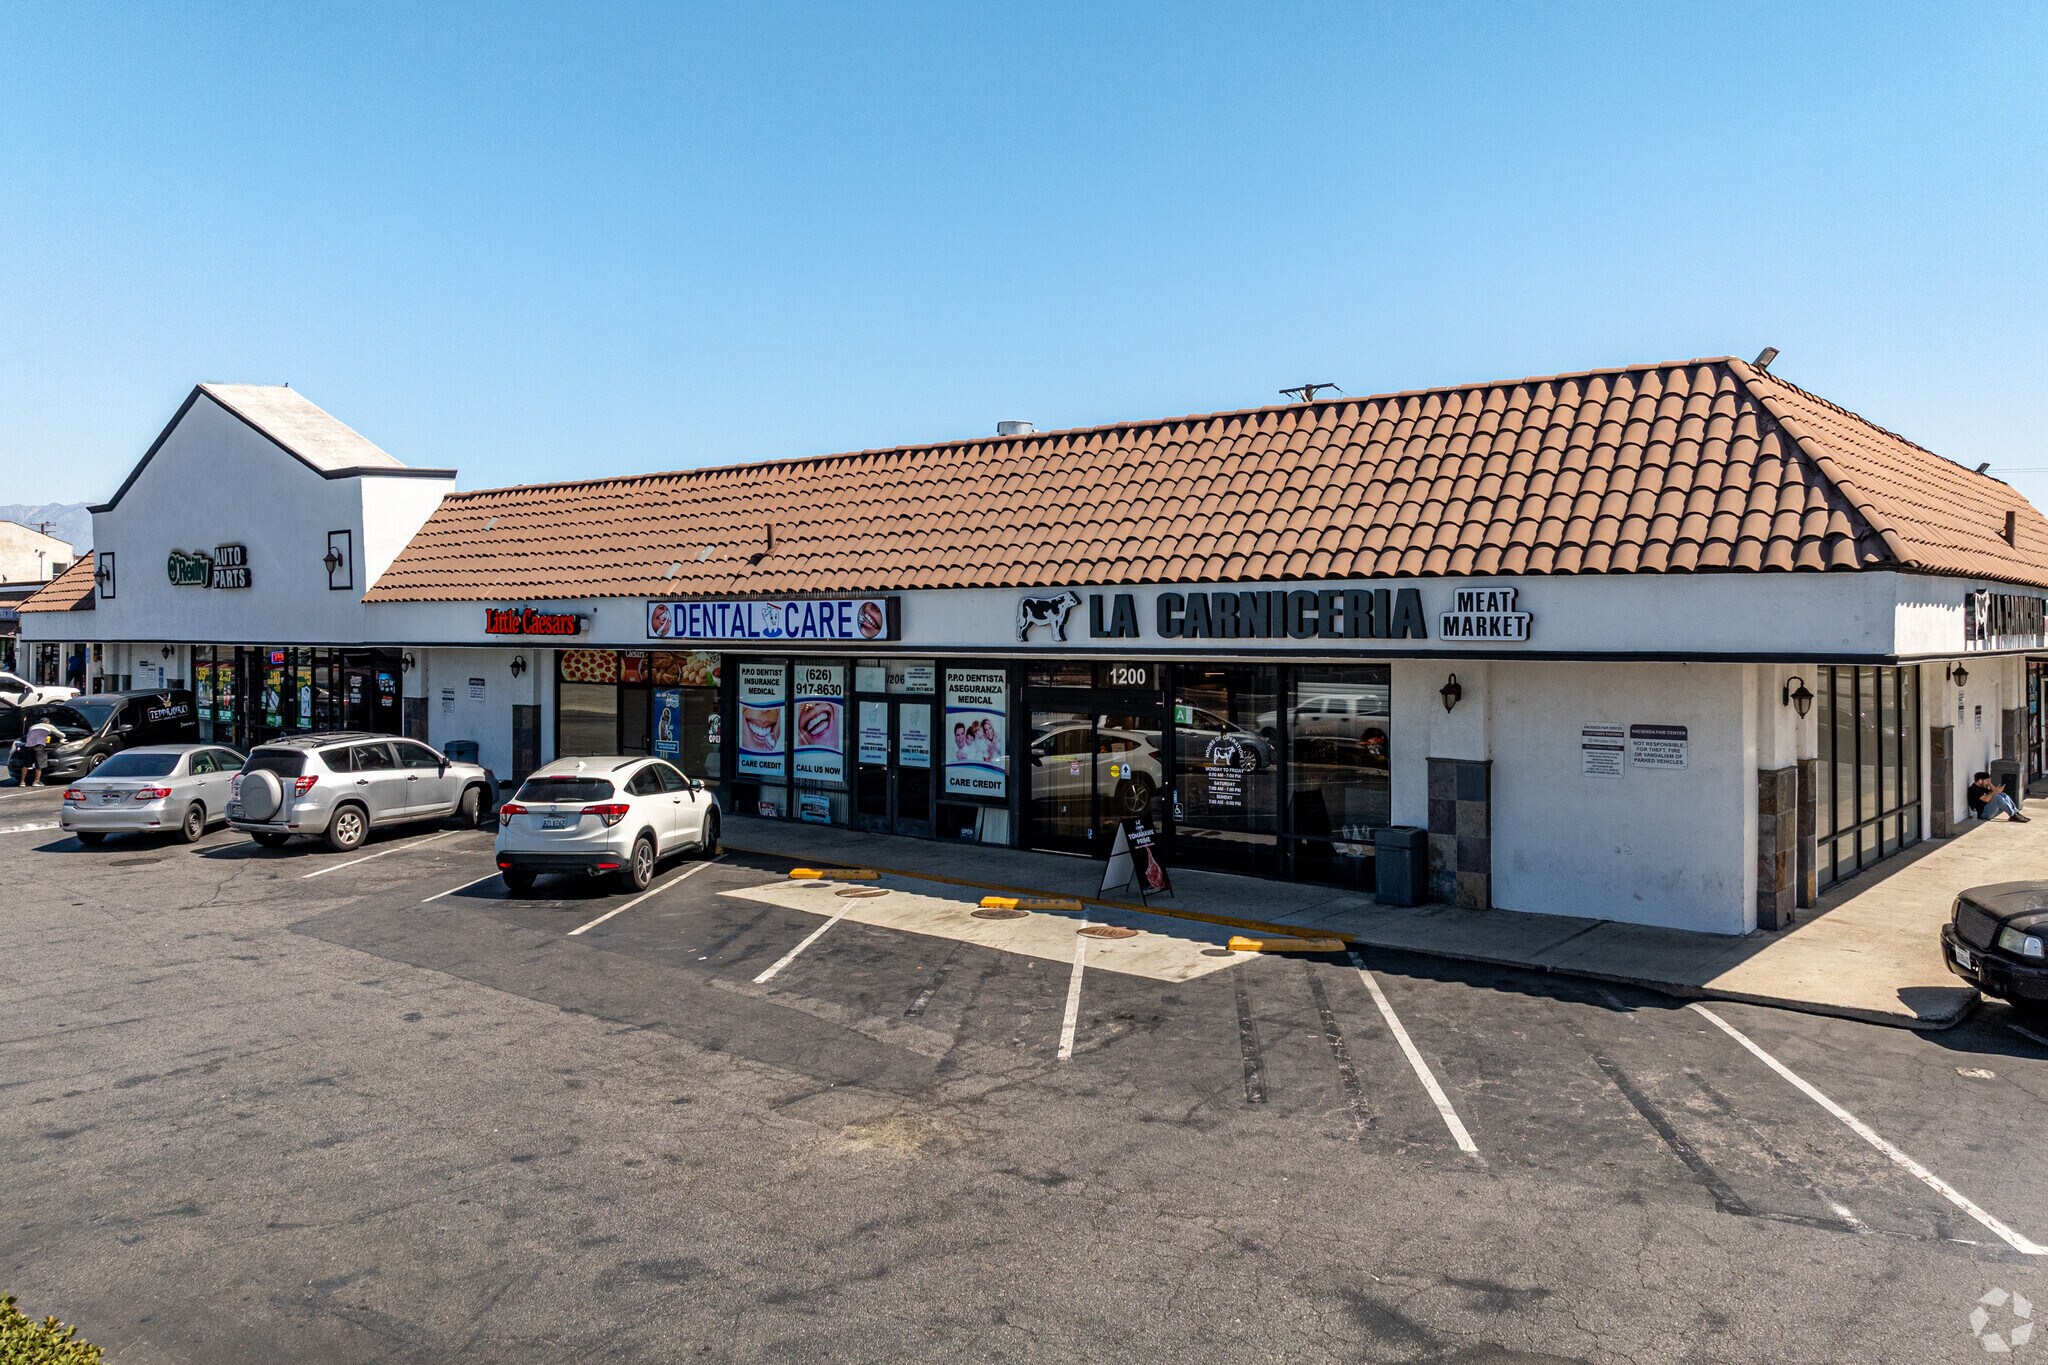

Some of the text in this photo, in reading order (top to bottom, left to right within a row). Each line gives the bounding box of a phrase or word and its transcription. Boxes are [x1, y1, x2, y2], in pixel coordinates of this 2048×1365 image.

[215, 546, 241, 566] AUTO
[168, 553, 209, 587] O'Reilly
[213, 569, 246, 588] PARTS
[1457, 591, 1512, 613] MEAT
[485, 608, 575, 635] Little Caesars
[674, 601, 853, 638] DENTAL CARE
[1089, 588, 1428, 640] LA CARNICERIA
[1443, 615, 1527, 639] MARKET
[744, 678, 780, 686] INSURANCE
[805, 668, 832, 683] (626)
[966, 674, 1004, 683] DENTISTA
[1110, 668, 1146, 685] 1200
[748, 687, 776, 695] MEDICAL
[796, 683, 842, 696] 917-8630
[949, 684, 1003, 694] ASEGURANZA
[957, 695, 993, 704] MEDICAL
[1205, 739, 1216, 758] HOURS
[1222, 734, 1244, 758] OPERATION
[741, 759, 782, 770] CARE CREDIT
[796, 764, 841, 775] CALL US NOW
[950, 777, 1002, 790] CARE CREDIT
[1128, 829, 1155, 840] TOMAHAWK
